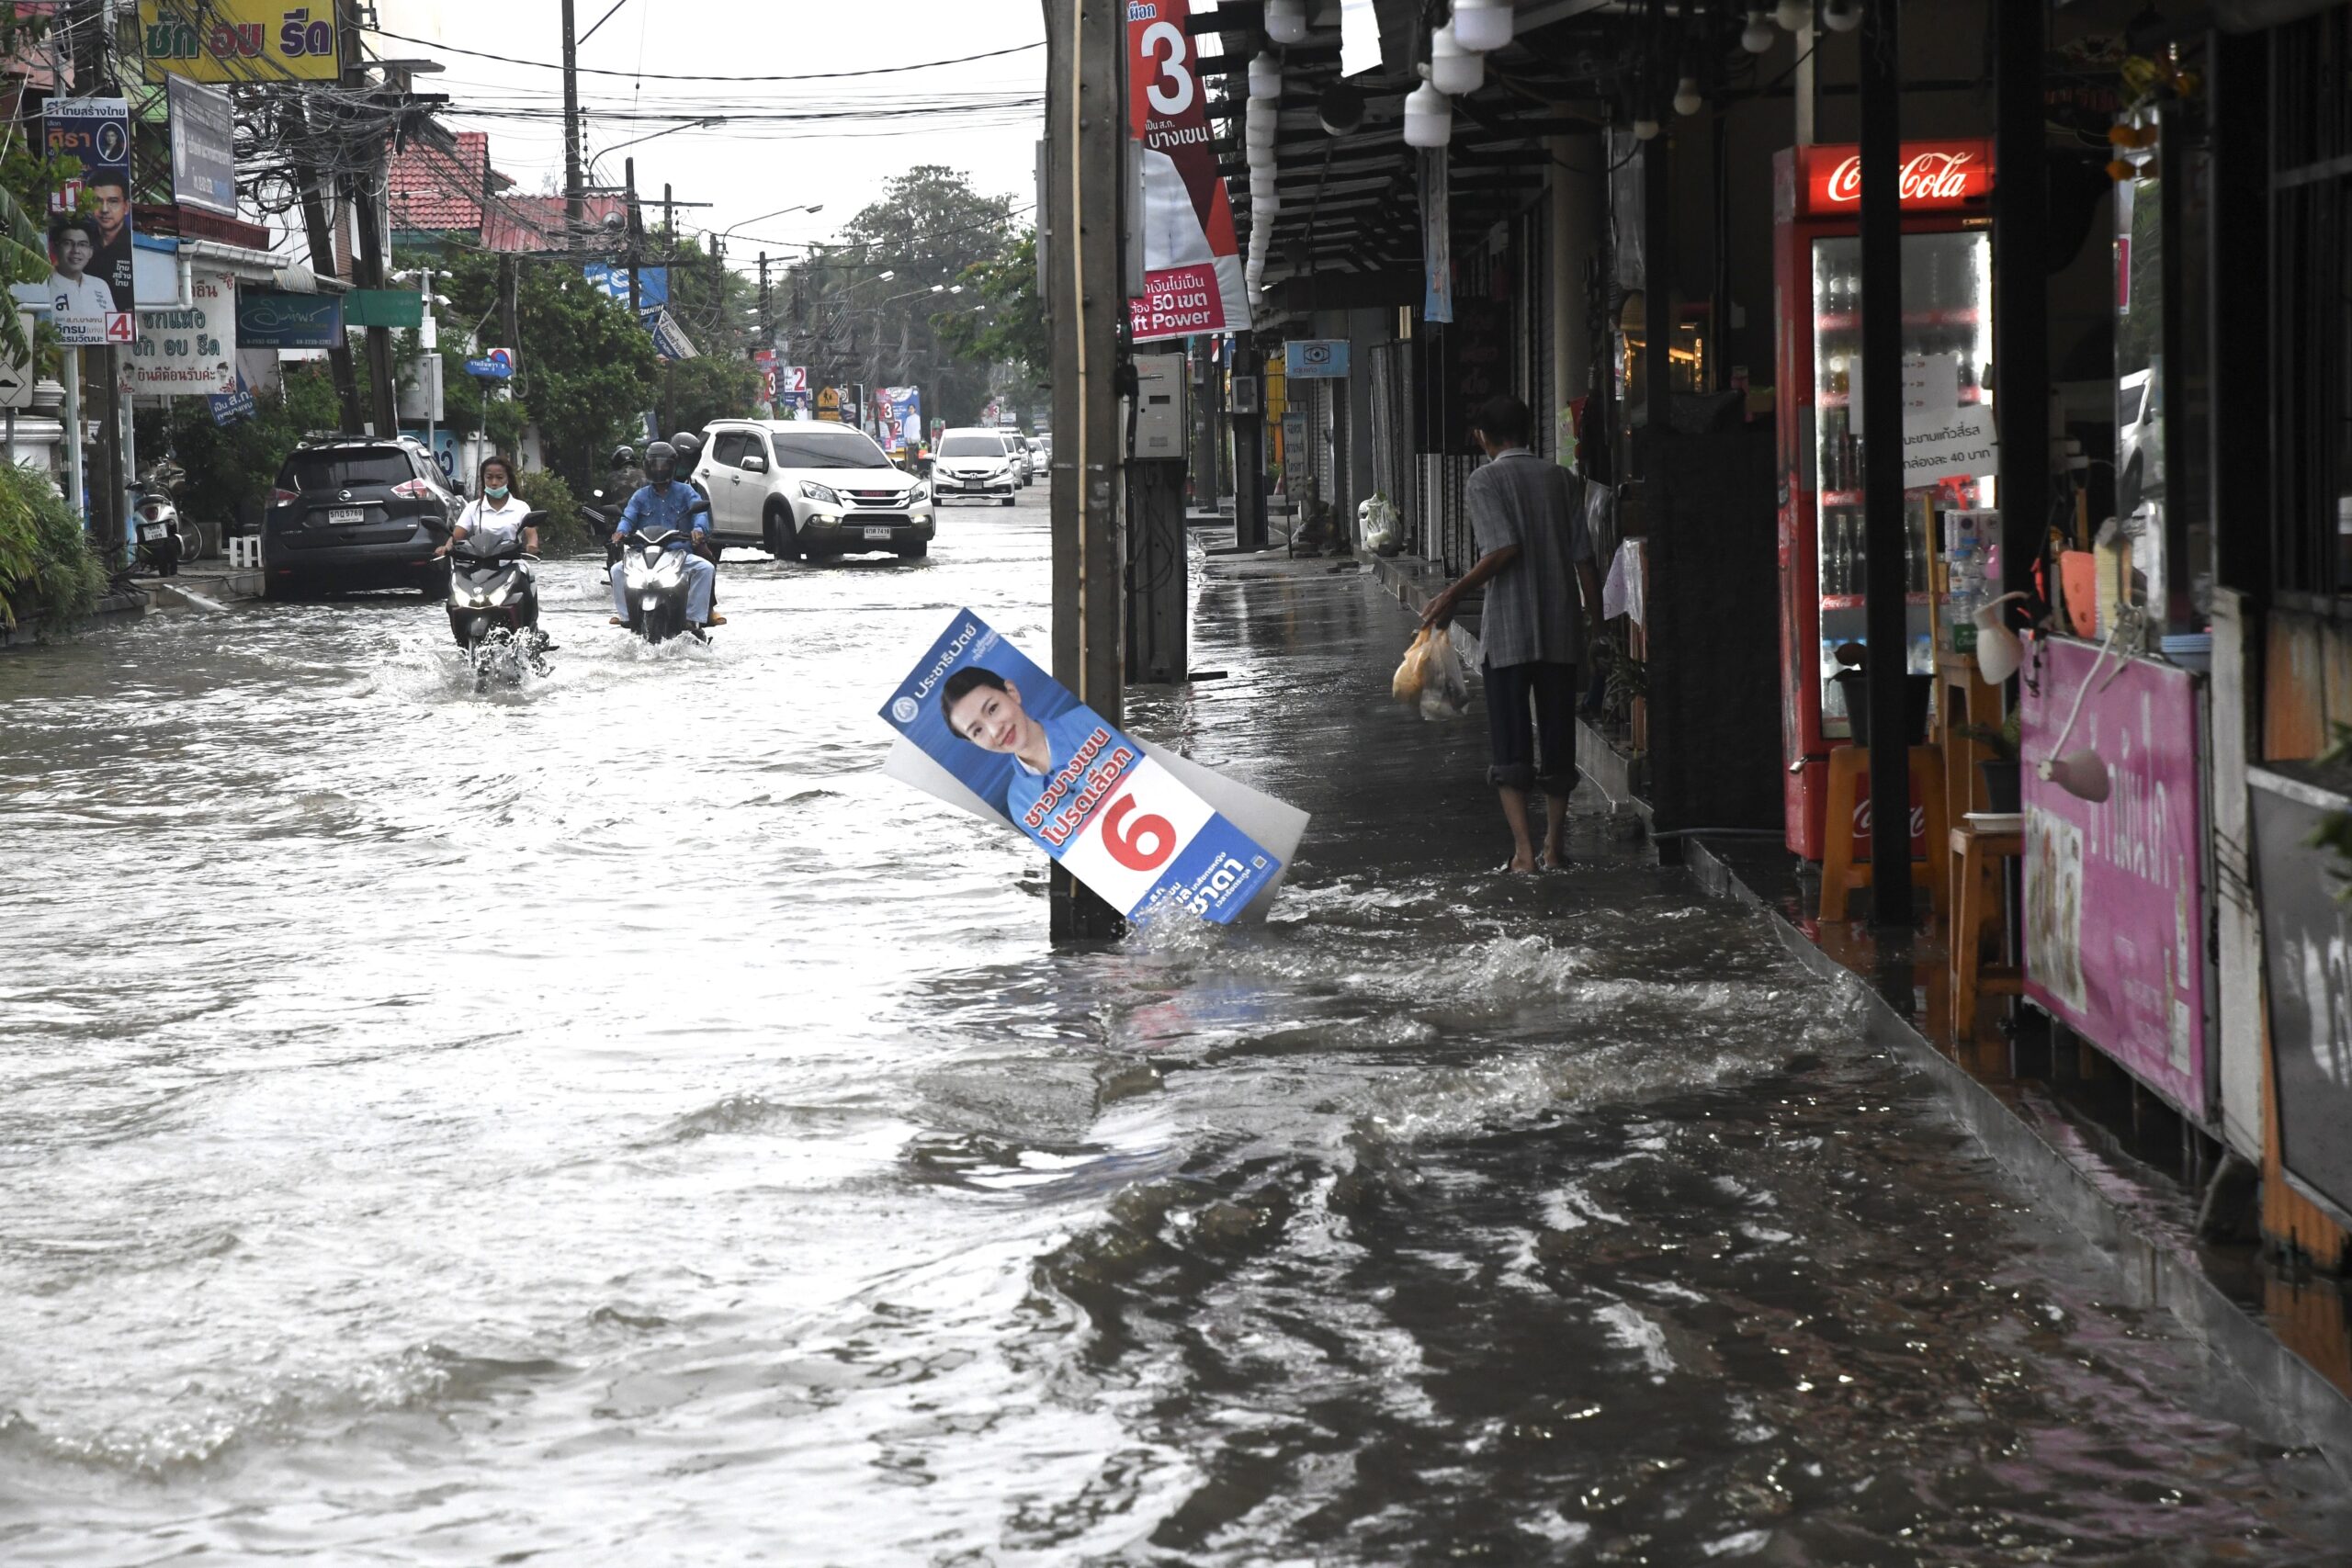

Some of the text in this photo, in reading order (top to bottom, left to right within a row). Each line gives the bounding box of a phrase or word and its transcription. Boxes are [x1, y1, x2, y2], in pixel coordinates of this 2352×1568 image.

[209, 22, 265, 58] อบ
[280, 8, 332, 56] รีด
[1141, 21, 1193, 116] 3
[62, 105, 126, 116] ไทยสร้างไทย
[1145, 119, 1175, 130] เป็น ส.ก.
[1148, 126, 1209, 149] บางเขน
[1153, 294, 1174, 311] 50
[1177, 293, 1207, 309] เขต
[109, 314, 130, 340] 4
[1152, 310, 1210, 329] Power
[164, 339, 188, 356] อบ
[197, 333, 220, 356] รีด
[138, 367, 215, 381] ยินดีต้อนรับค่ะ
[769, 372, 775, 395] 3
[794, 367, 805, 390] 2
[229, 391, 253, 406] ส.ก.
[993, 405, 1000, 414] 3
[884, 402, 892, 419] 3
[1903, 449, 1990, 469] กล่องละ 40 บาท
[914, 622, 977, 699] ประชาธิปัตย์
[1023, 727, 1111, 828] ชาวบางเขน
[1040, 747, 1134, 845] โปรดเลือก
[1102, 793, 1177, 872] 6
[1186, 858, 1244, 914] ชาดา
